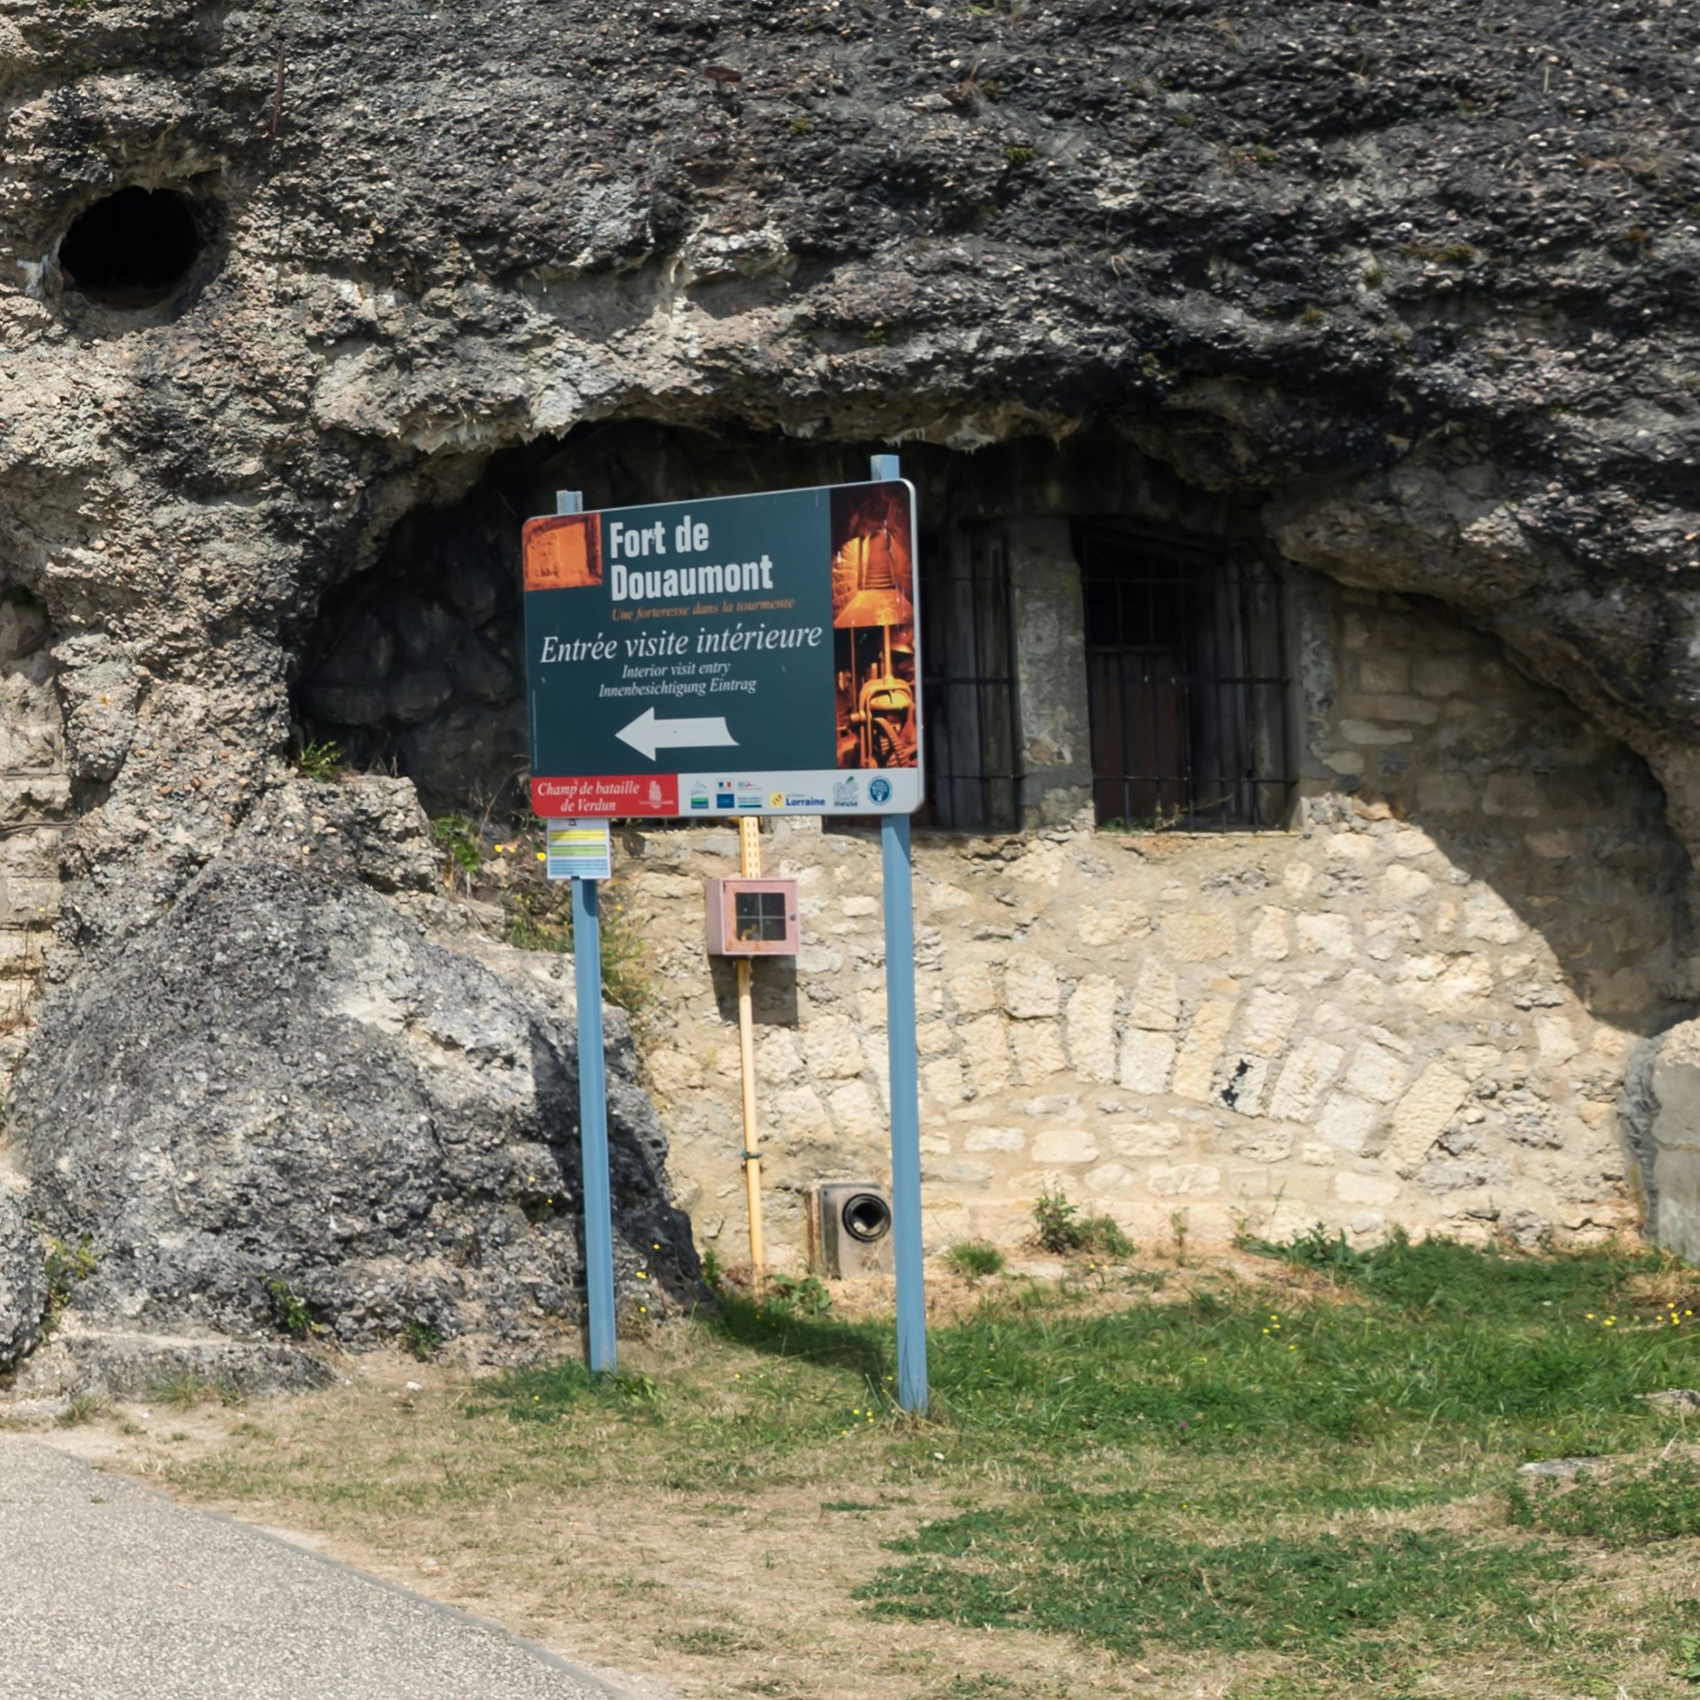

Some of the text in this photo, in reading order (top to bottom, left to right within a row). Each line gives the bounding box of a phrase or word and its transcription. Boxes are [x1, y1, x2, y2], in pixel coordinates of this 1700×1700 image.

[610, 515, 709, 559] Fort de
[611, 554, 774, 601] Douaumont
[612, 598, 795, 623] Une forteresse dans la tourmente
[540, 623, 823, 663] Entrée visite intérieure
[622, 661, 731, 679] Interior visit entry
[598, 678, 757, 698] Innenbesichtigung Eintrag
[538, 780, 640, 798] Champ de bataille
[561, 799, 616, 812] de Verdun
[786, 798, 826, 806] Lorraine
